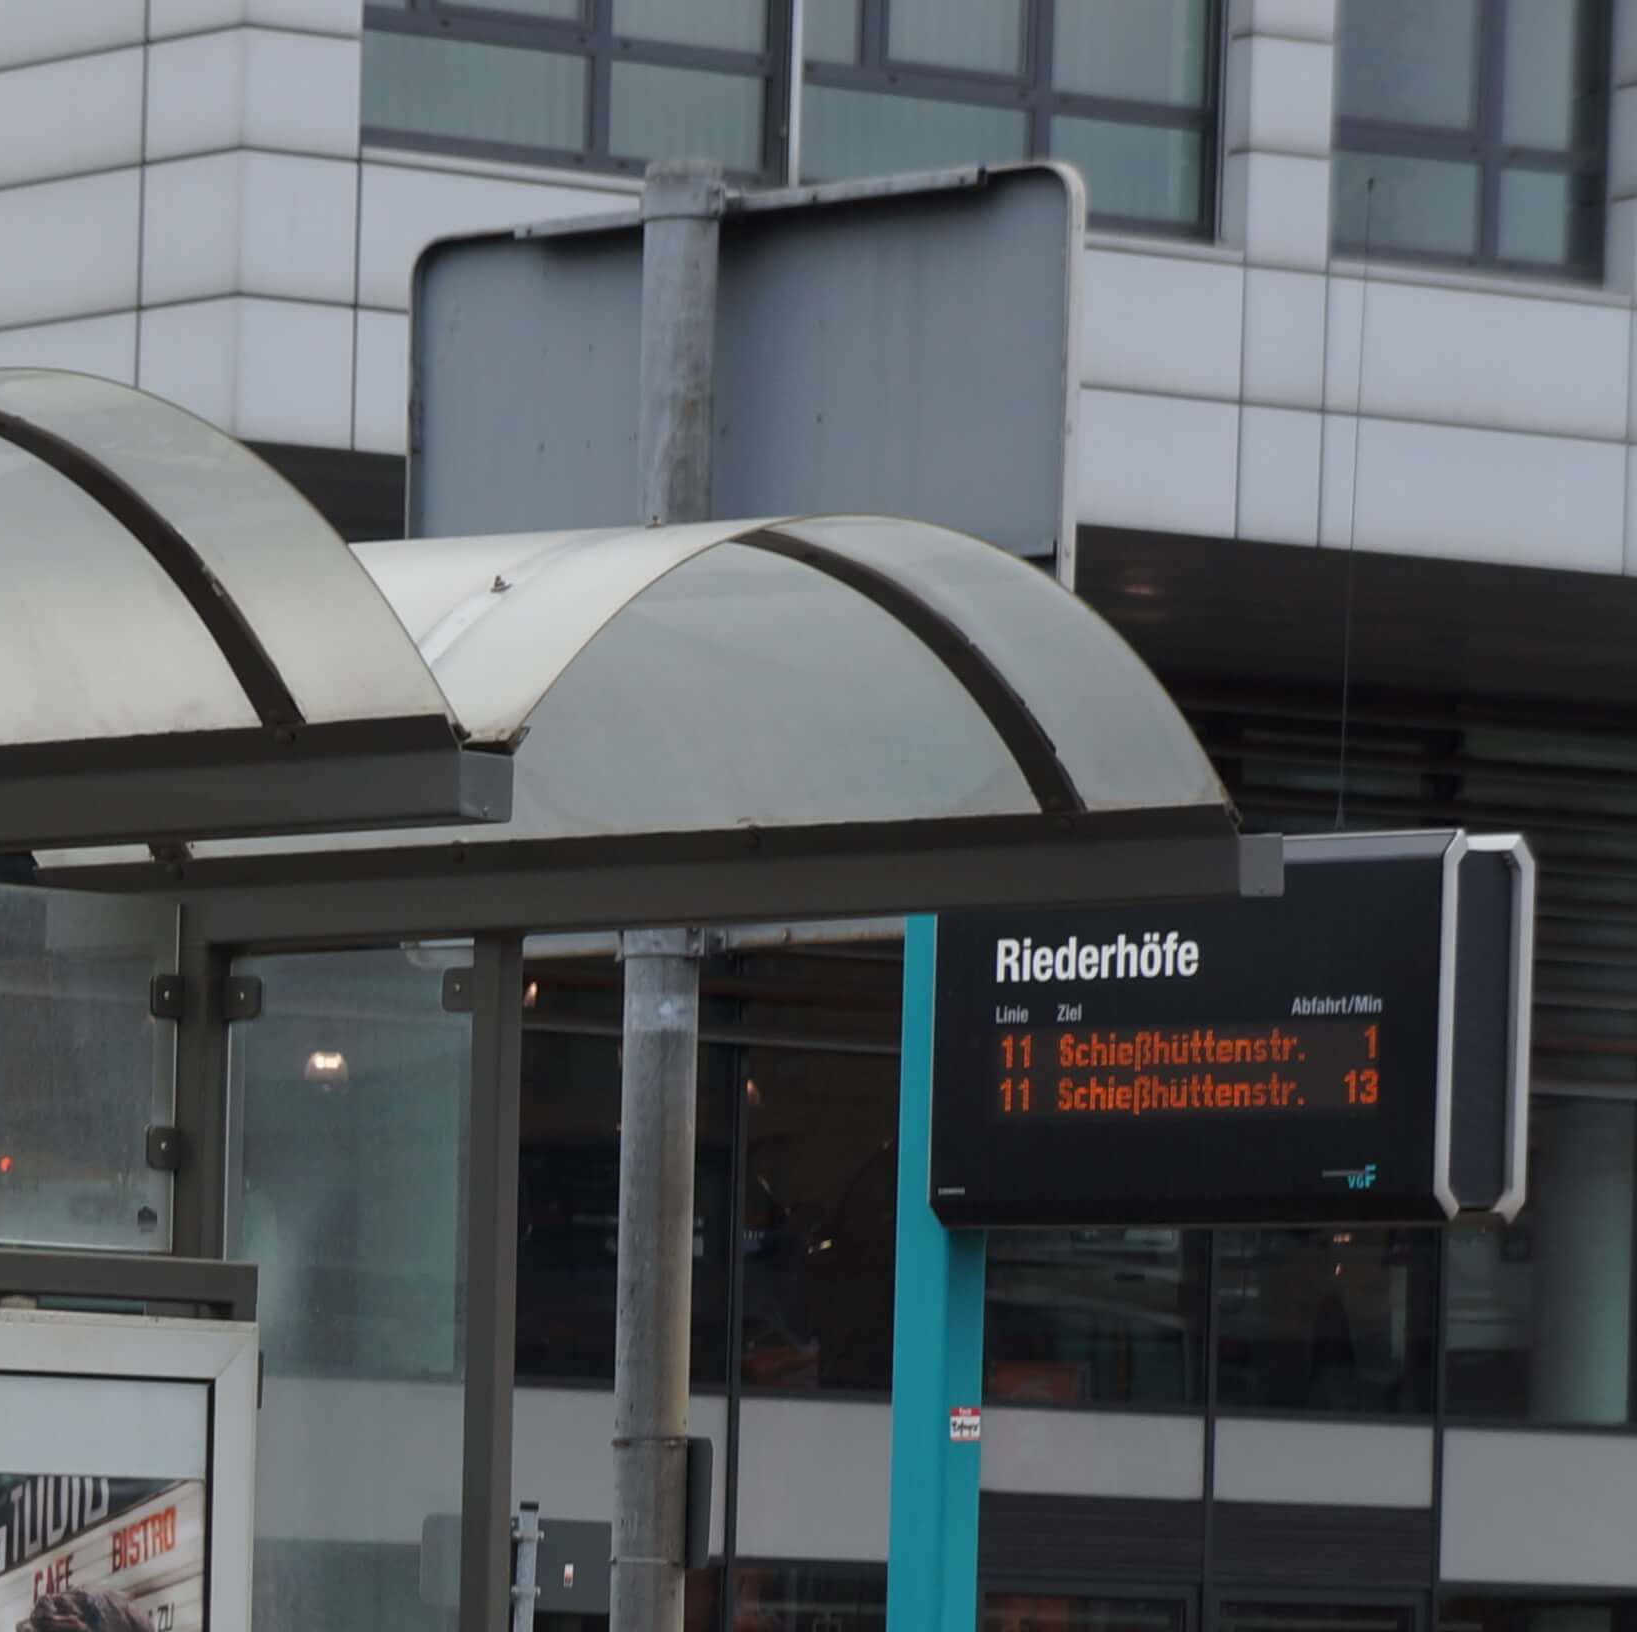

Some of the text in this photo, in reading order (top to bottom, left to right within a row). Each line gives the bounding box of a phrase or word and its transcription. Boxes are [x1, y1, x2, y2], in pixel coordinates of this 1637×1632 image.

[995, 931, 1200, 983] Riederhöfe
[995, 995, 1383, 1025] Linie Ziel Abfahrt/Min
[1001, 1024, 1379, 1073] 11 Schießhüttenstr. 1
[999, 1068, 1379, 1116] 11 Schießhüttenstr. 13
[111, 1504, 177, 1574] BISTRO
